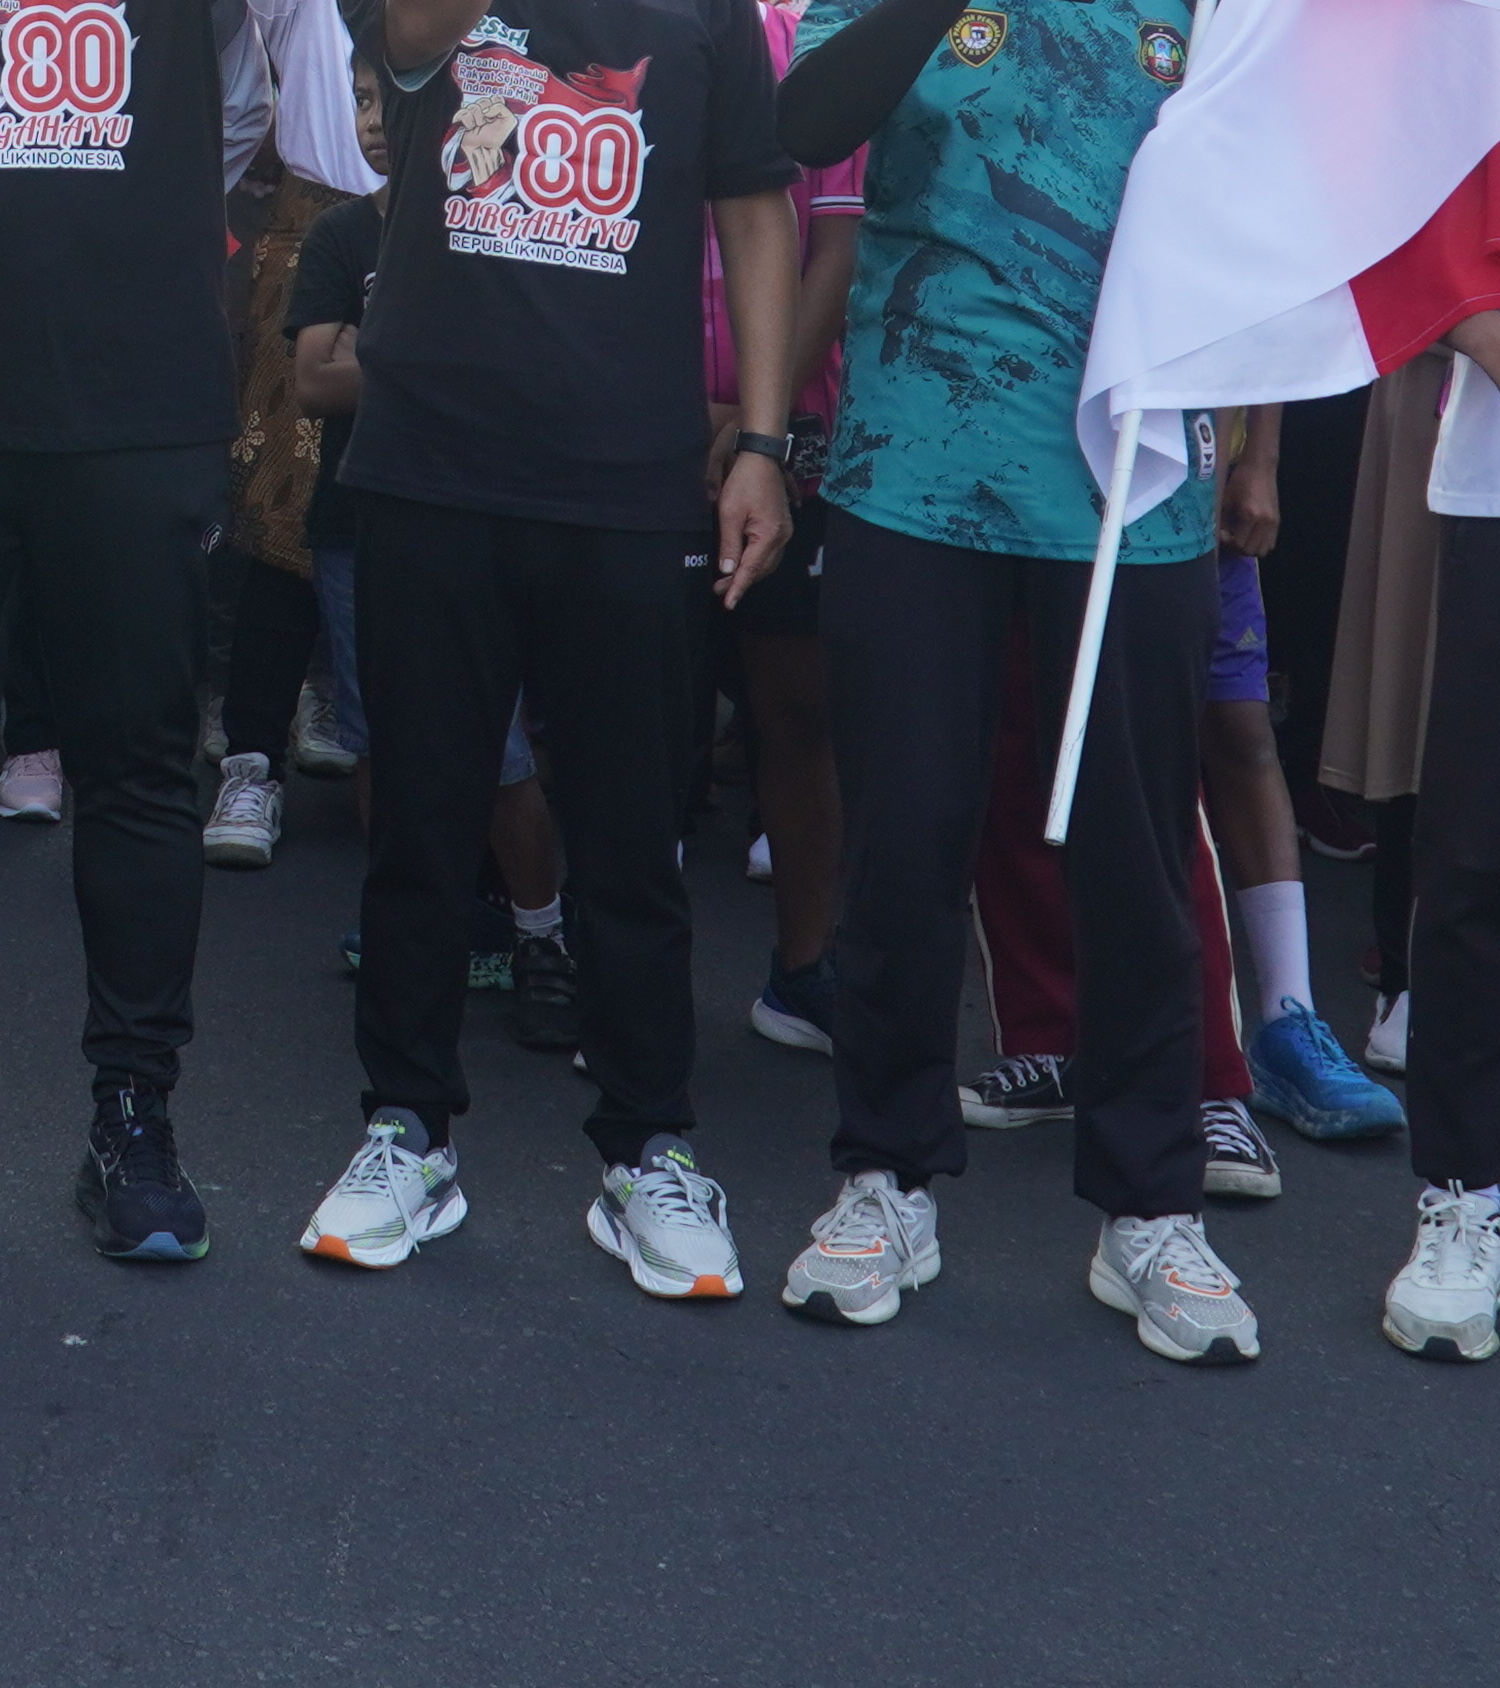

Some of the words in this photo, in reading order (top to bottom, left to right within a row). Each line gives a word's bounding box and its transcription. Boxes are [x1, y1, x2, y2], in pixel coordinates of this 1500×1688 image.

[6, 6, 129, 115] 80
[457, 53, 500, 71] Bersatu
[500, 59, 548, 82] Berdaulat
[458, 67, 497, 86] Rakyat
[497, 72, 545, 94] Sejahtera
[462, 81, 514, 98] Indonesia
[514, 89, 539, 105] Maju
[31, 150, 123, 167] INDONESIA
[515, 105, 644, 220] 80
[444, 196, 641, 252] DIRGAHAYU
[450, 233, 536, 258] REPUBLIK
[535, 247, 626, 272] INDONESIA
[684, 553, 709, 569] BOSS
